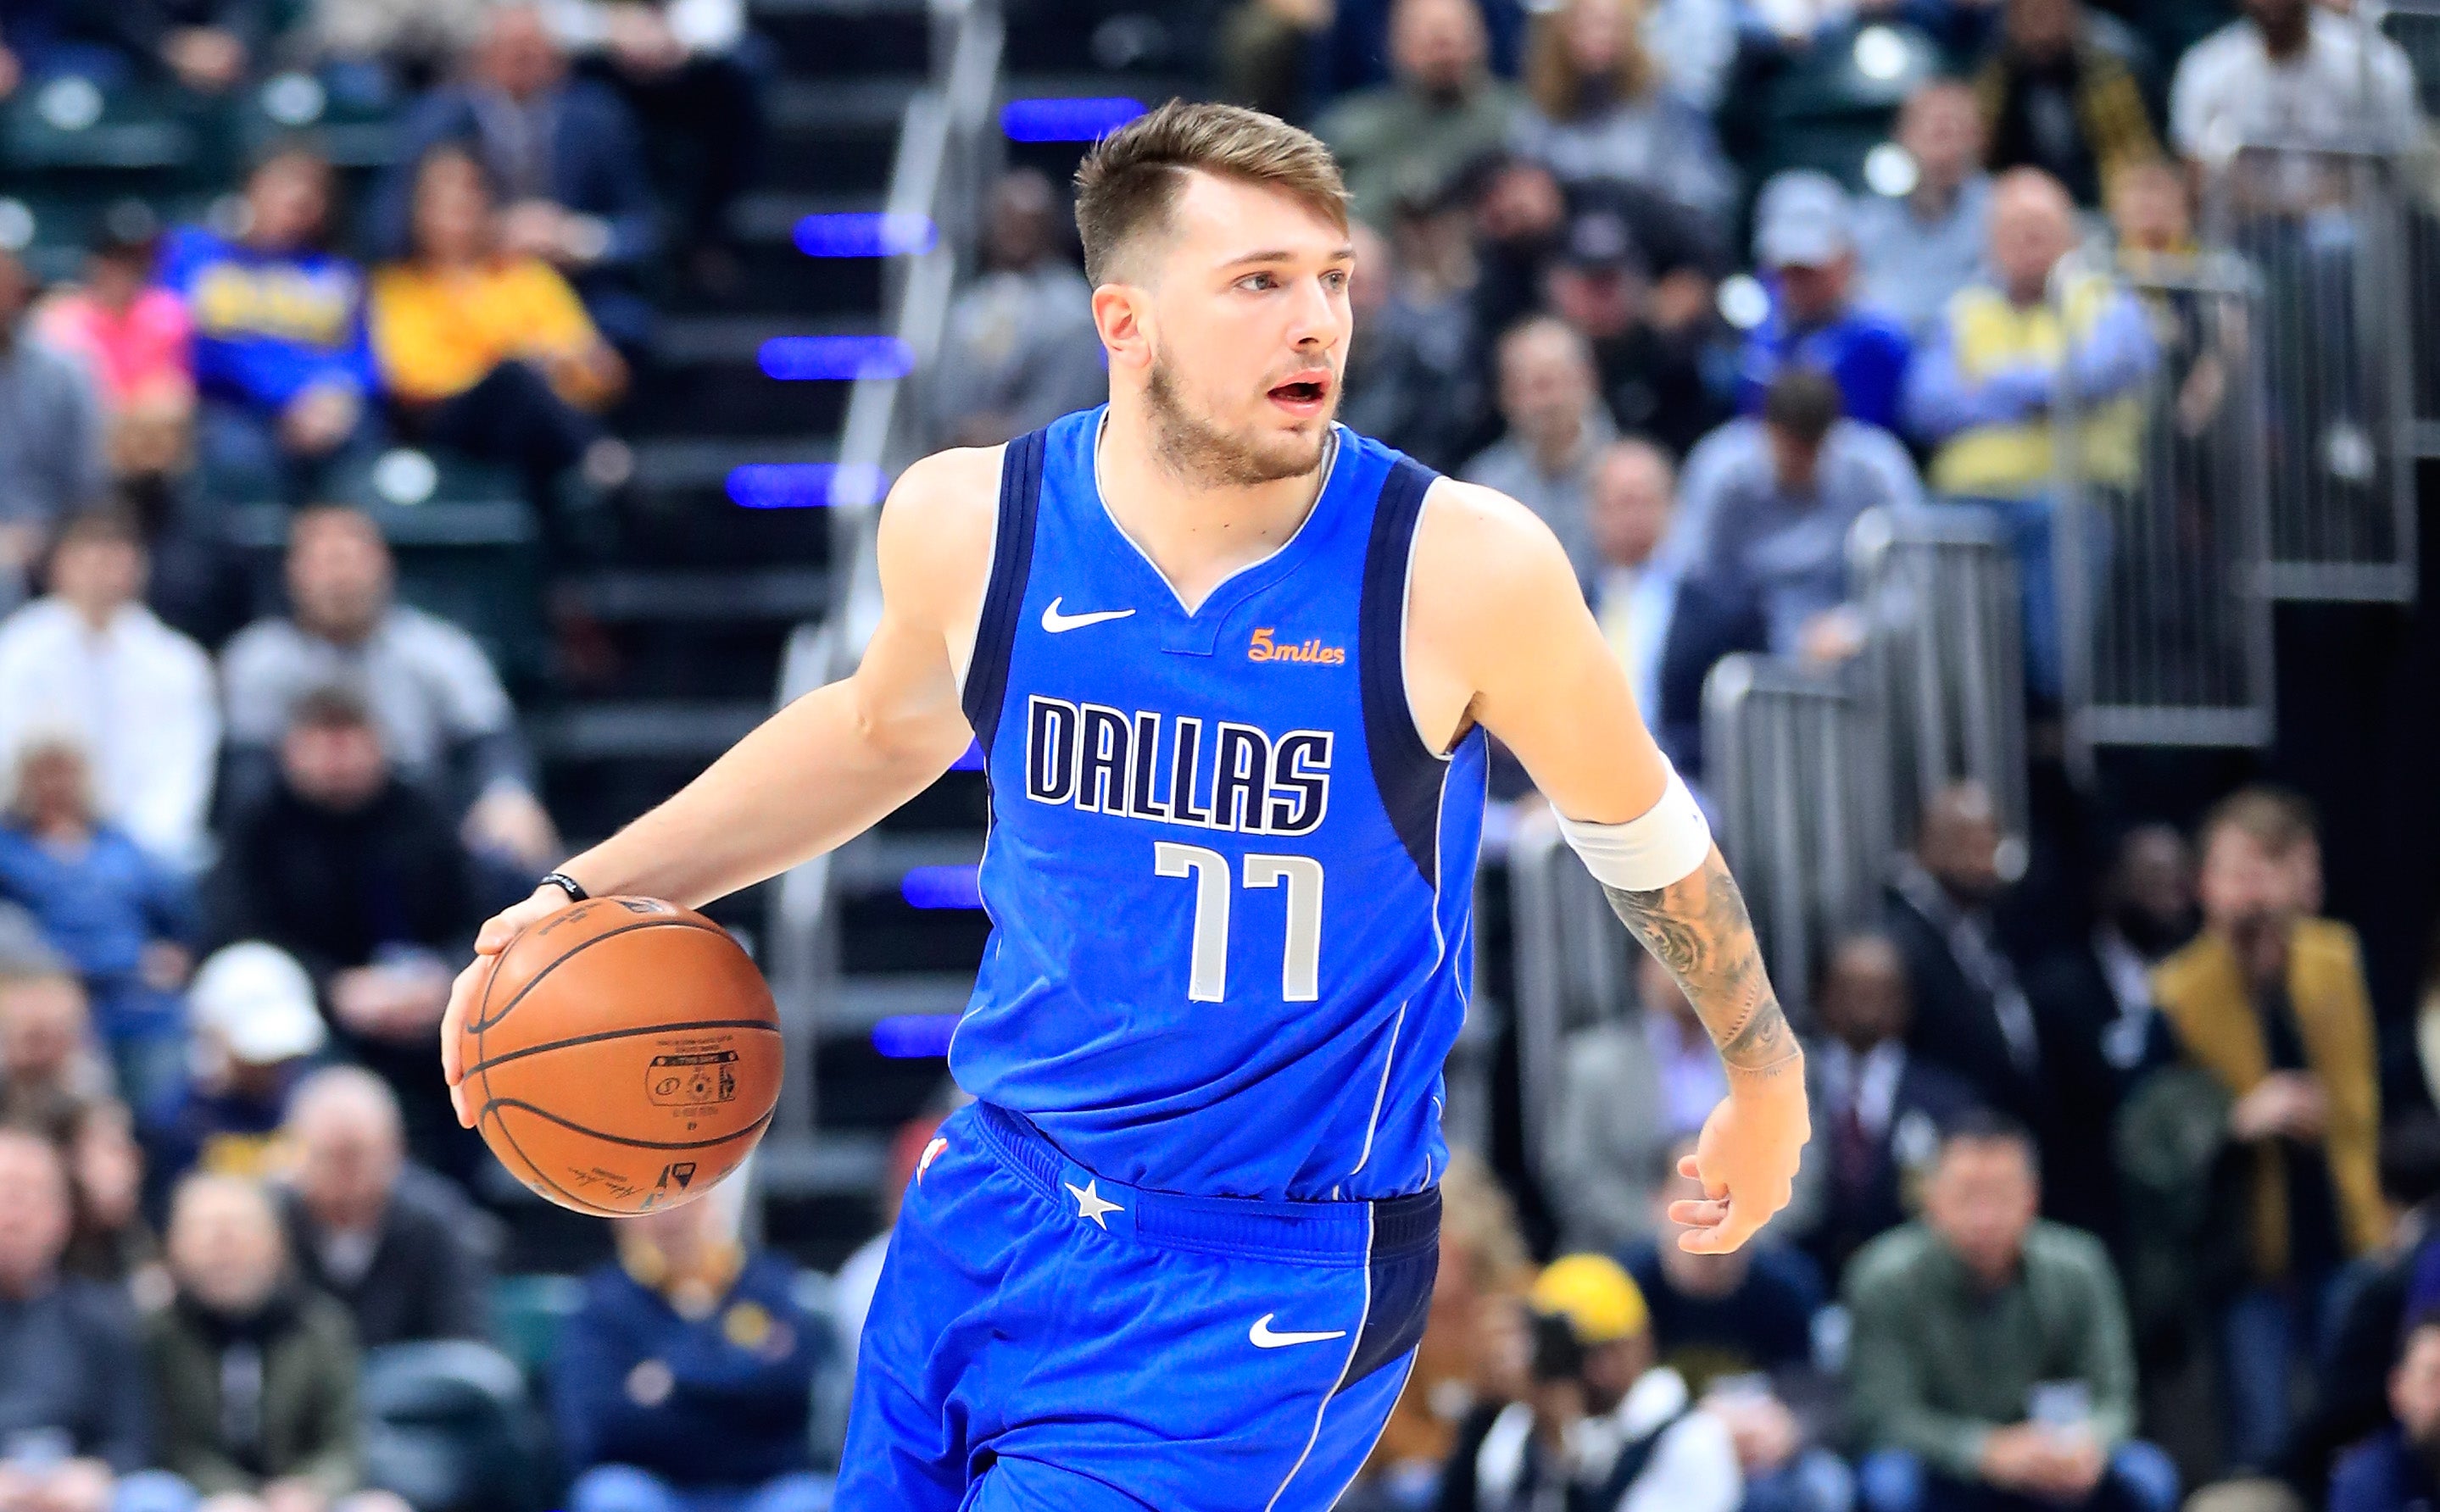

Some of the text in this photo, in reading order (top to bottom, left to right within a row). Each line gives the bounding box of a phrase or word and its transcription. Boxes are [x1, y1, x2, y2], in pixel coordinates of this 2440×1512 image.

[1248, 628, 1345, 665] 5miles
[1026, 694, 1334, 837] DALLAS
[1154, 842, 1324, 1003] 77
